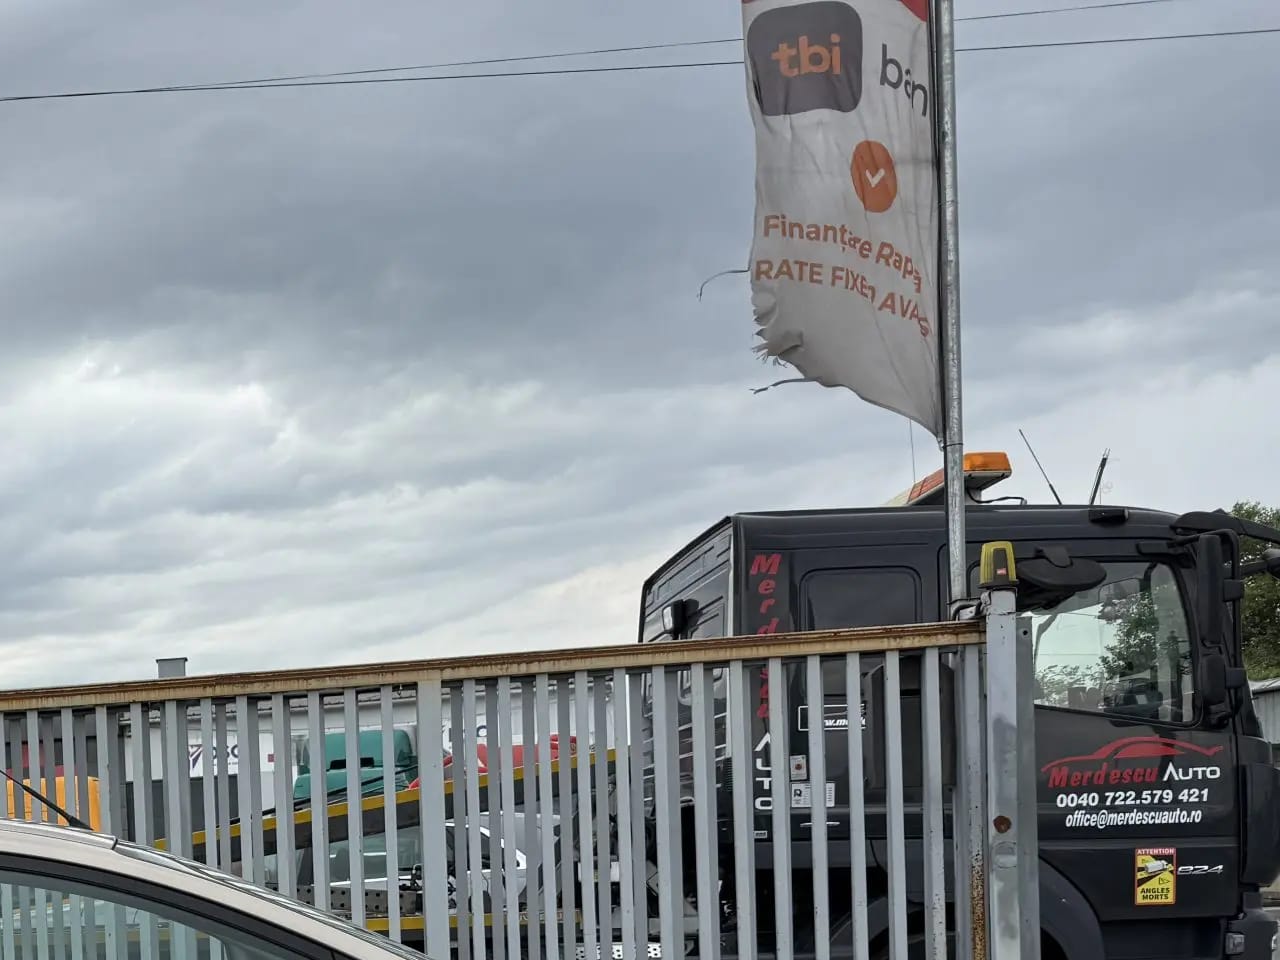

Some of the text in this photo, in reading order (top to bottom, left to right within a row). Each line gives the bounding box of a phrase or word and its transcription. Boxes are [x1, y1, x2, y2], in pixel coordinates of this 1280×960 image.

[771, 33, 842, 78] tbi
[755, 259, 824, 285] RATE
[1048, 761, 1221, 788] Merdescu AUTO
[1056, 788, 1210, 808] 0040 722.579 421
[1065, 808, 1202, 829] office@merdescuauto.ro
[1136, 847, 1175, 856] ATTENTION
